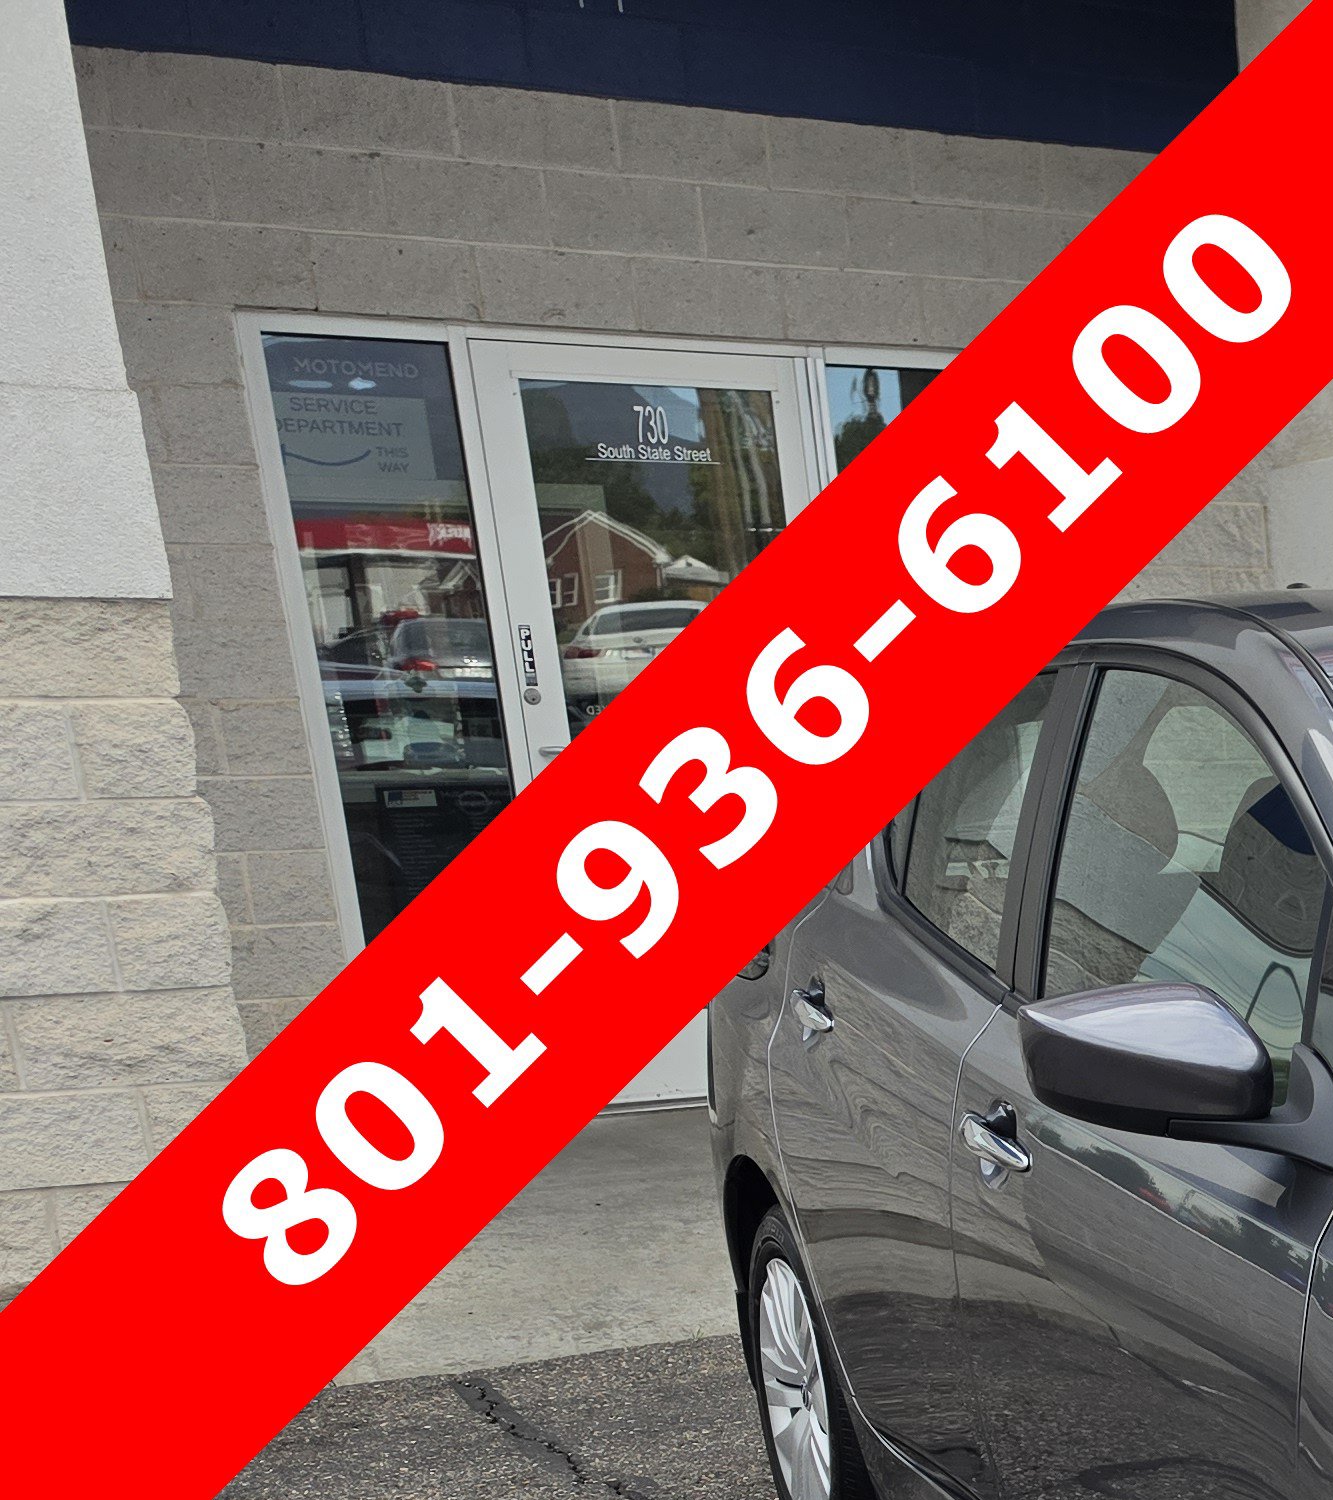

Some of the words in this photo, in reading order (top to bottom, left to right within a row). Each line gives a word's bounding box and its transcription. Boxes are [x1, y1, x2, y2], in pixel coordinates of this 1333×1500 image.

[292, 356, 419, 379] MOTOMEND
[289, 396, 378, 415] SERVICE
[633, 405, 669, 444] 730
[376, 446, 409, 459] THIS
[597, 443, 635, 459] South
[638, 445, 671, 461] State
[674, 446, 712, 462] Street
[377, 462, 410, 474] WAY
[520, 628, 535, 673] PULL
